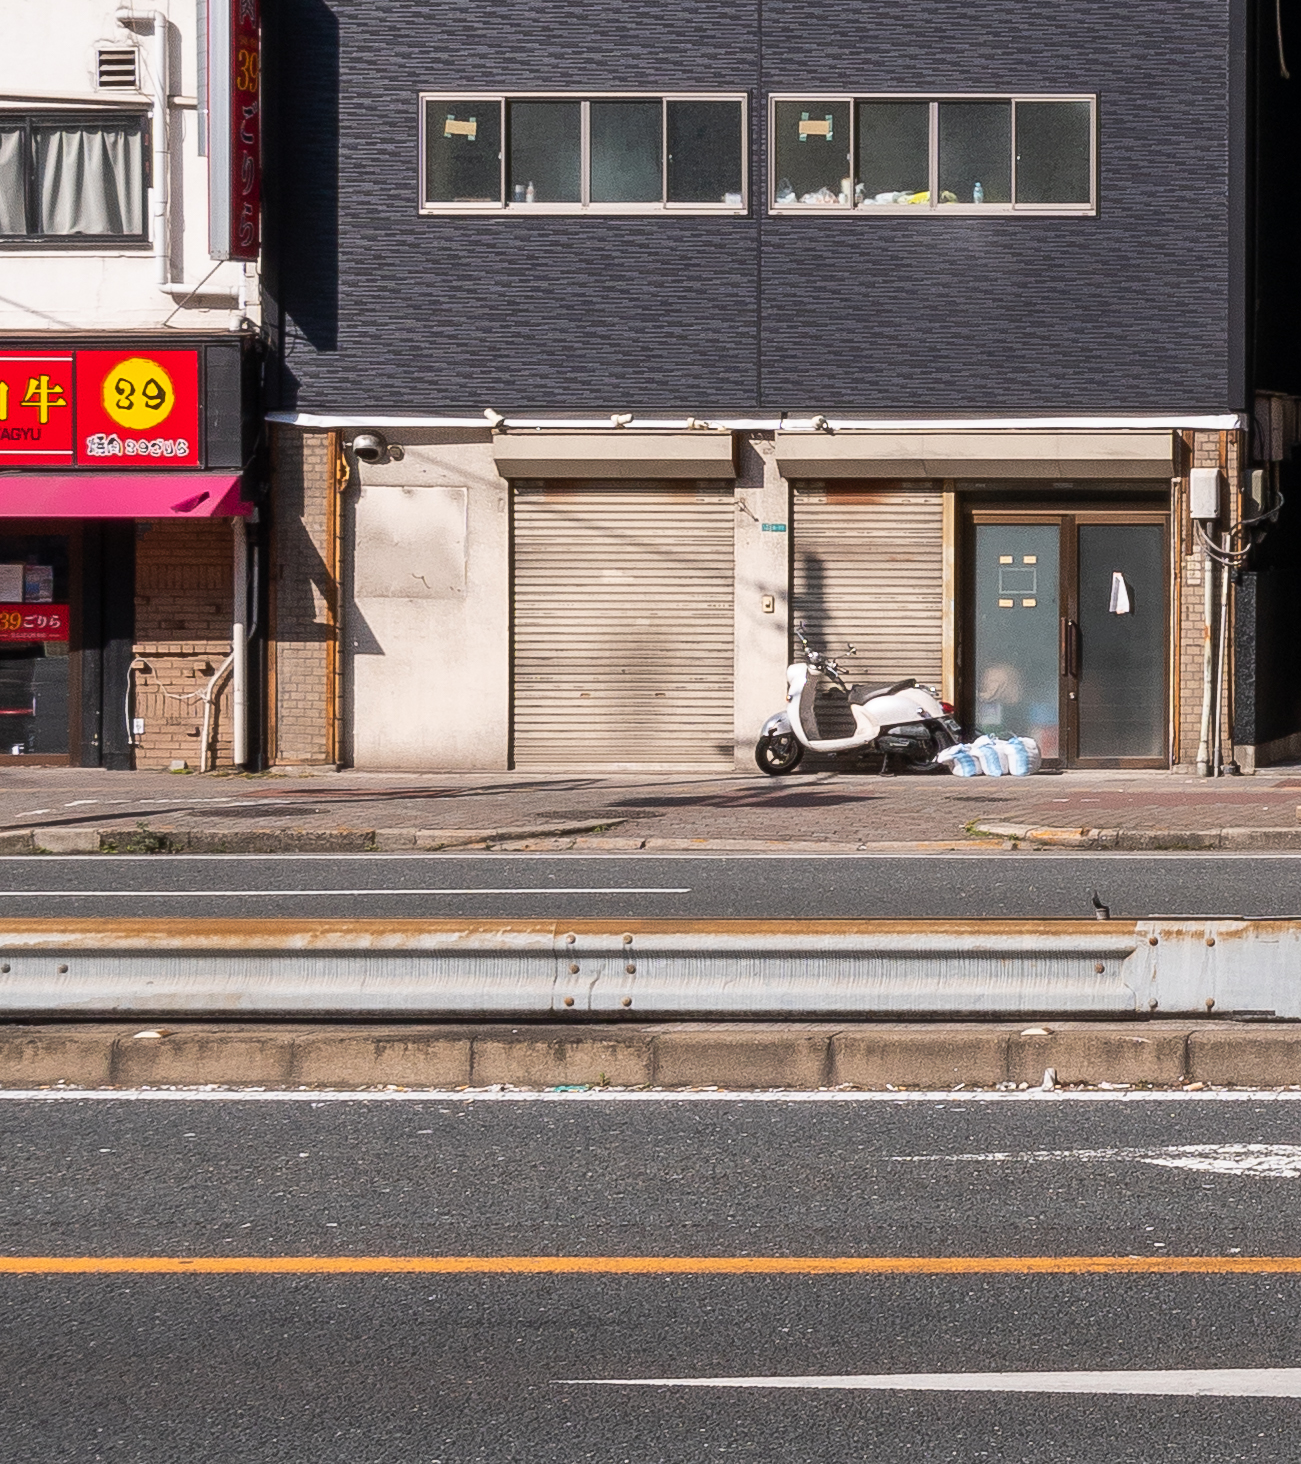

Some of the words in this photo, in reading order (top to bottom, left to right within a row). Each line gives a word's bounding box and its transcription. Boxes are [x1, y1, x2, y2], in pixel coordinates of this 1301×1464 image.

[236, 48, 258, 93] 39
[239, 100, 258, 248] ごりら
[0, 374, 67, 425] 牛
[114, 377, 167, 411] 39
[0, 427, 41, 441] AGYU
